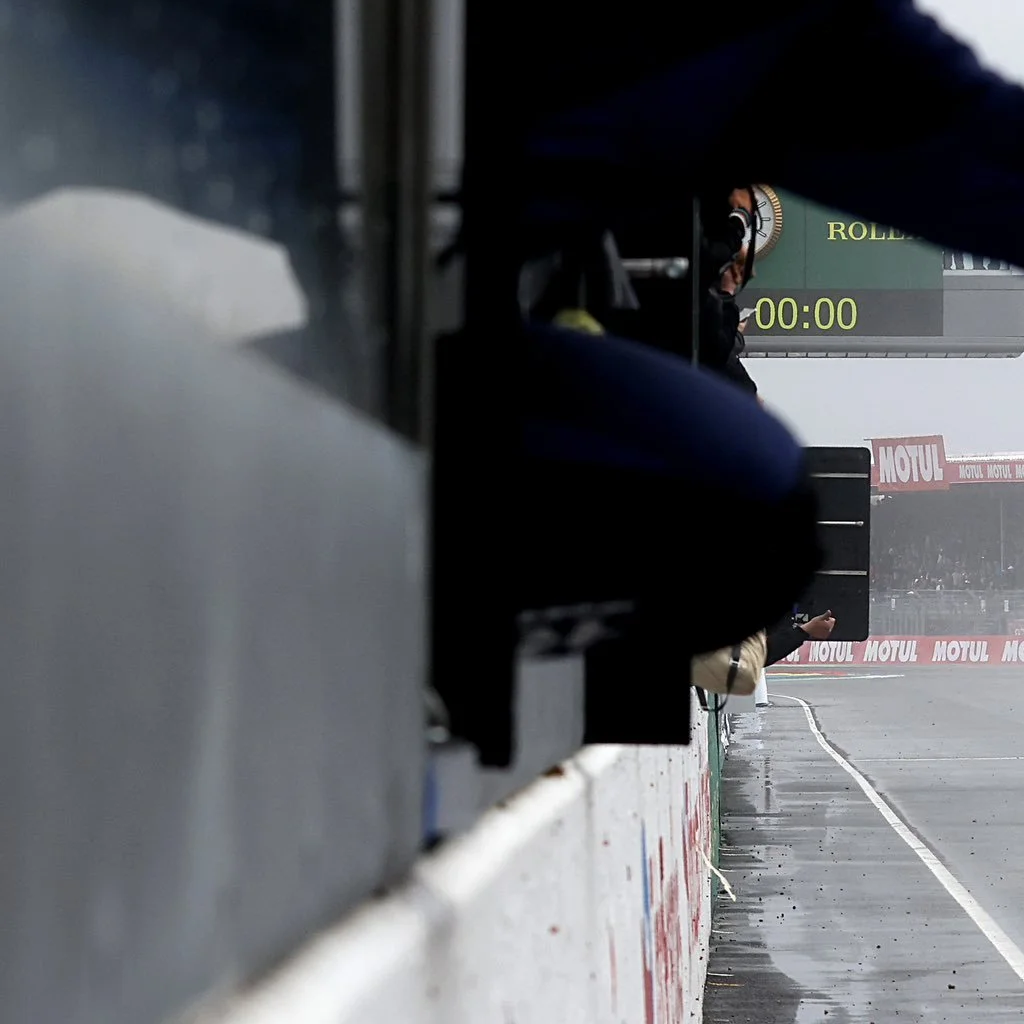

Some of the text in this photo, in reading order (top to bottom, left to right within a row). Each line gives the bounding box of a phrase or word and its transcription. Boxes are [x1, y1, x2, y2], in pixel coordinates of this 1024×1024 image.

[827, 221, 922, 240] ROLE
[755, 297, 857, 329] 00:00
[879, 444, 943, 483] MOTUL
[959, 464, 983, 479] MOTUL
[987, 464, 1012, 479] MOTUL
[809, 640, 854, 662] MOTUL
[863, 640, 918, 662] MOTUL
[932, 640, 989, 662] MOTUL
